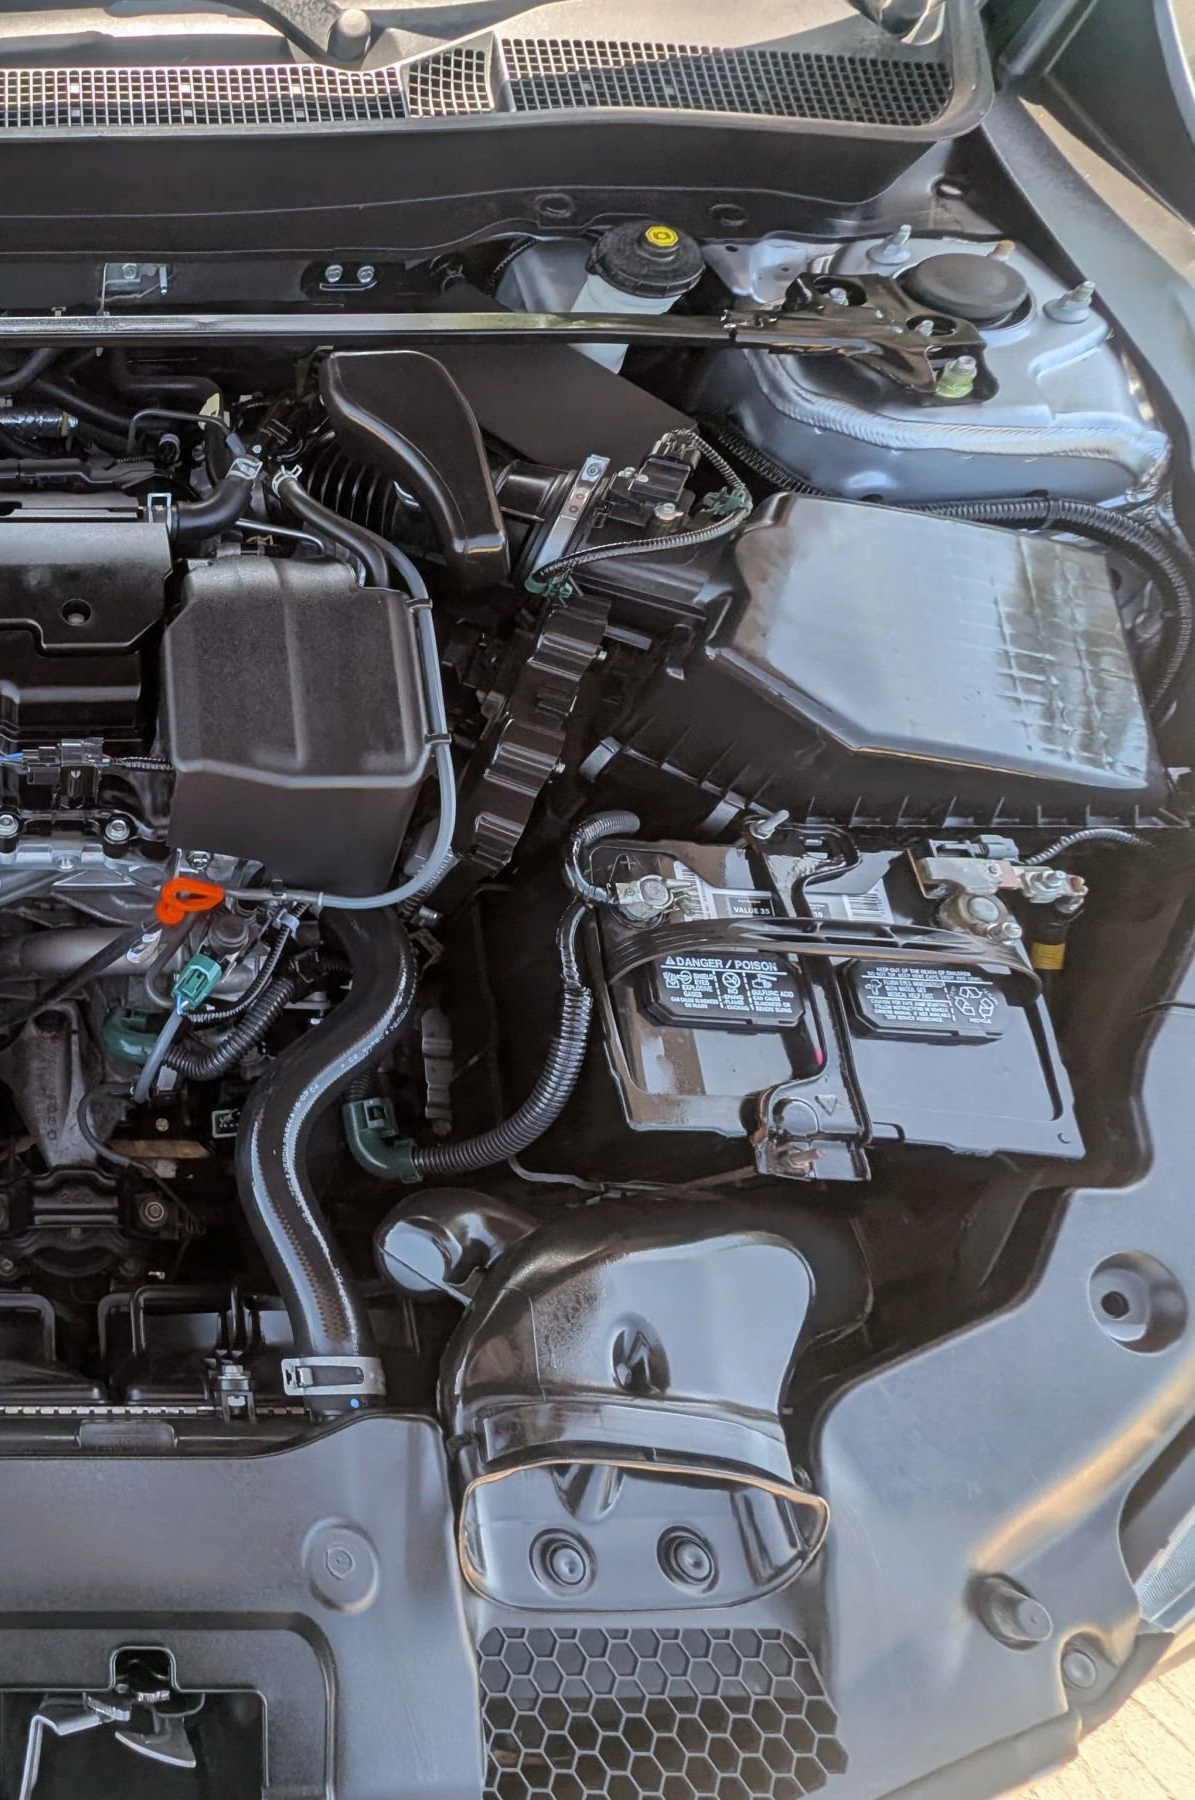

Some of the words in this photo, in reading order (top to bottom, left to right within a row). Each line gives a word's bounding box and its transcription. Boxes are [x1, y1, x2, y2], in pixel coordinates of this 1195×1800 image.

[733, 906, 758, 914] VALUE
[676, 957, 723, 968] DANGER
[725, 960, 731, 968] /
[735, 960, 777, 971] POISON
